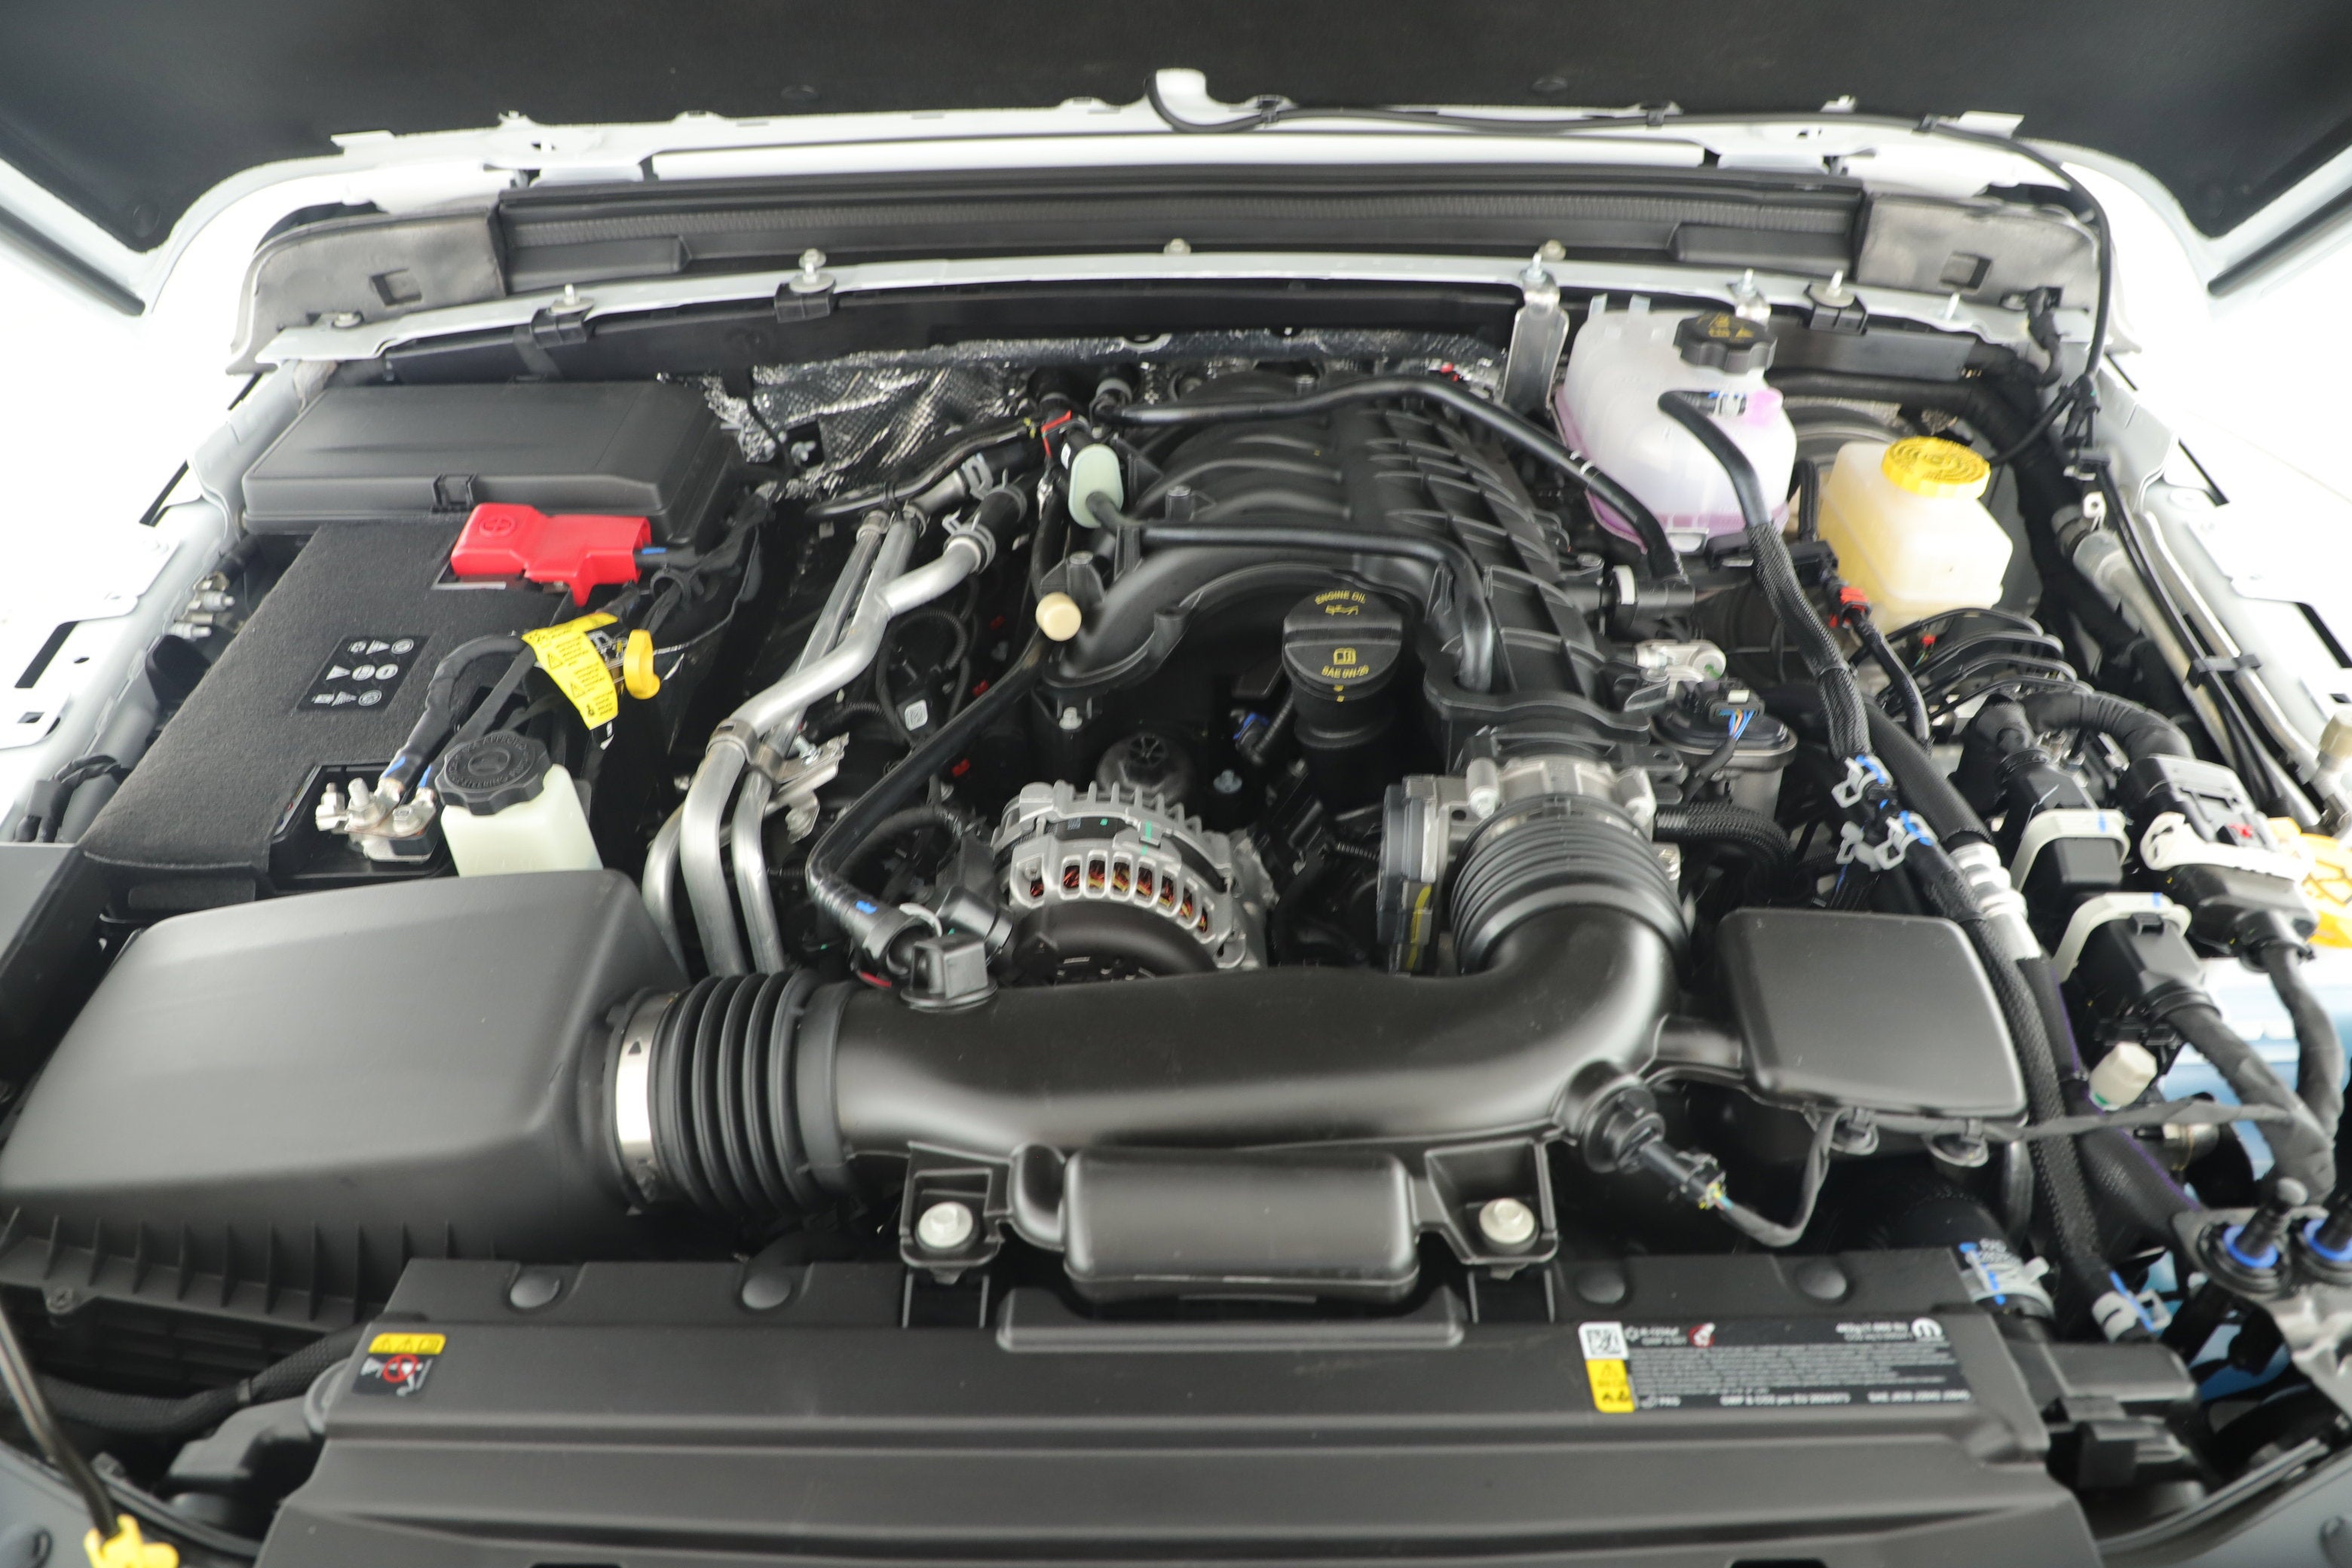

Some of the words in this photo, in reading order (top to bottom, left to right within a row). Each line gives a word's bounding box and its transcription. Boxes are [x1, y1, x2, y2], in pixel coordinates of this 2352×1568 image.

[1315, 590, 1350, 605] ENGINE
[1352, 591, 1366, 604] OIL
[1321, 665, 1341, 678] SAE
